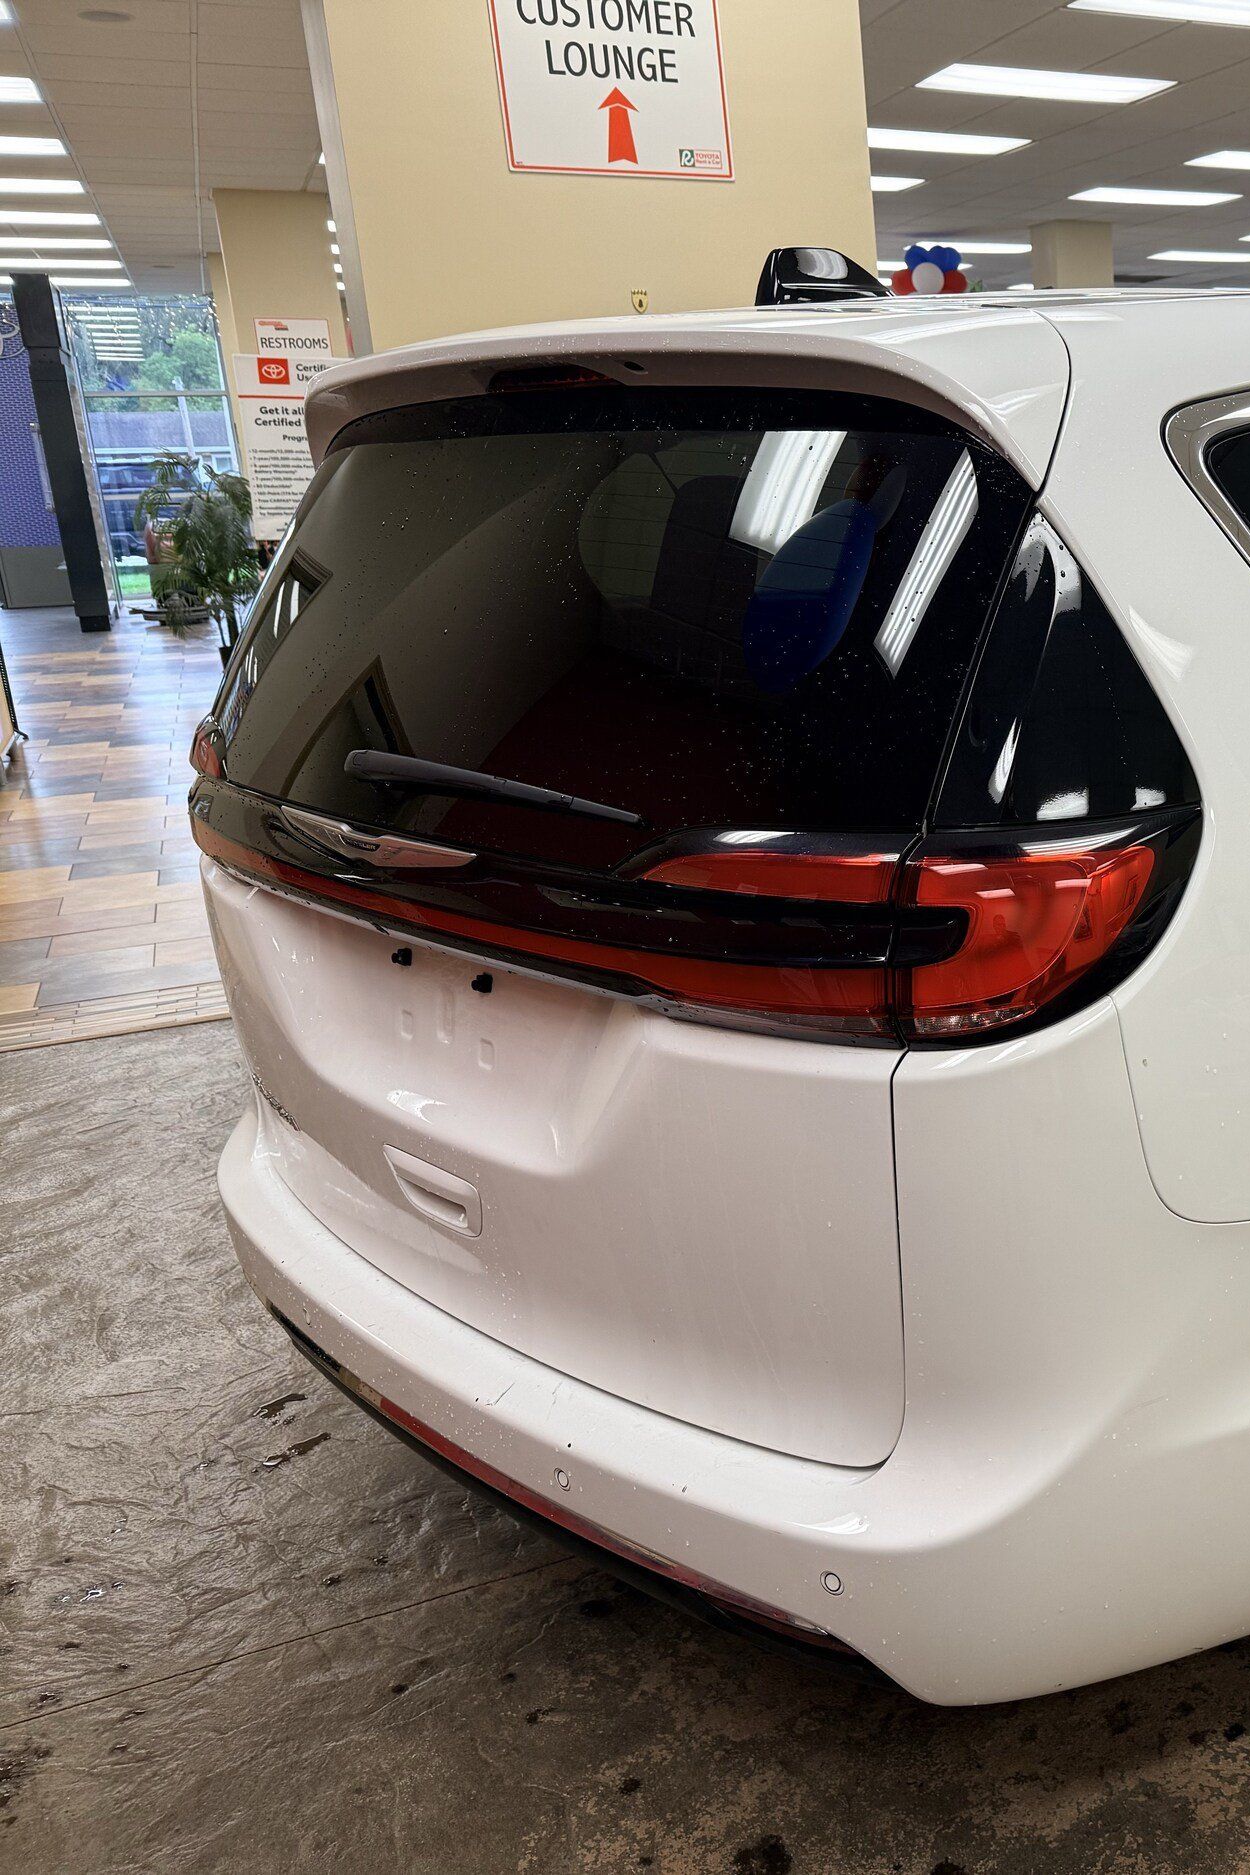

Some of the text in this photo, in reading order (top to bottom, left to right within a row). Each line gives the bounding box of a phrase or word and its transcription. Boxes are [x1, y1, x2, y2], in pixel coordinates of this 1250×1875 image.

[516, 0, 696, 37] CUSTOMER
[545, 40, 679, 83] LOUNGE
[260, 337, 329, 349] RESTROOMS
[295, 364, 331, 372] Certifi
[297, 373, 312, 382] Us
[260, 406, 305, 415] Get it all
[255, 418, 301, 427] Certified
